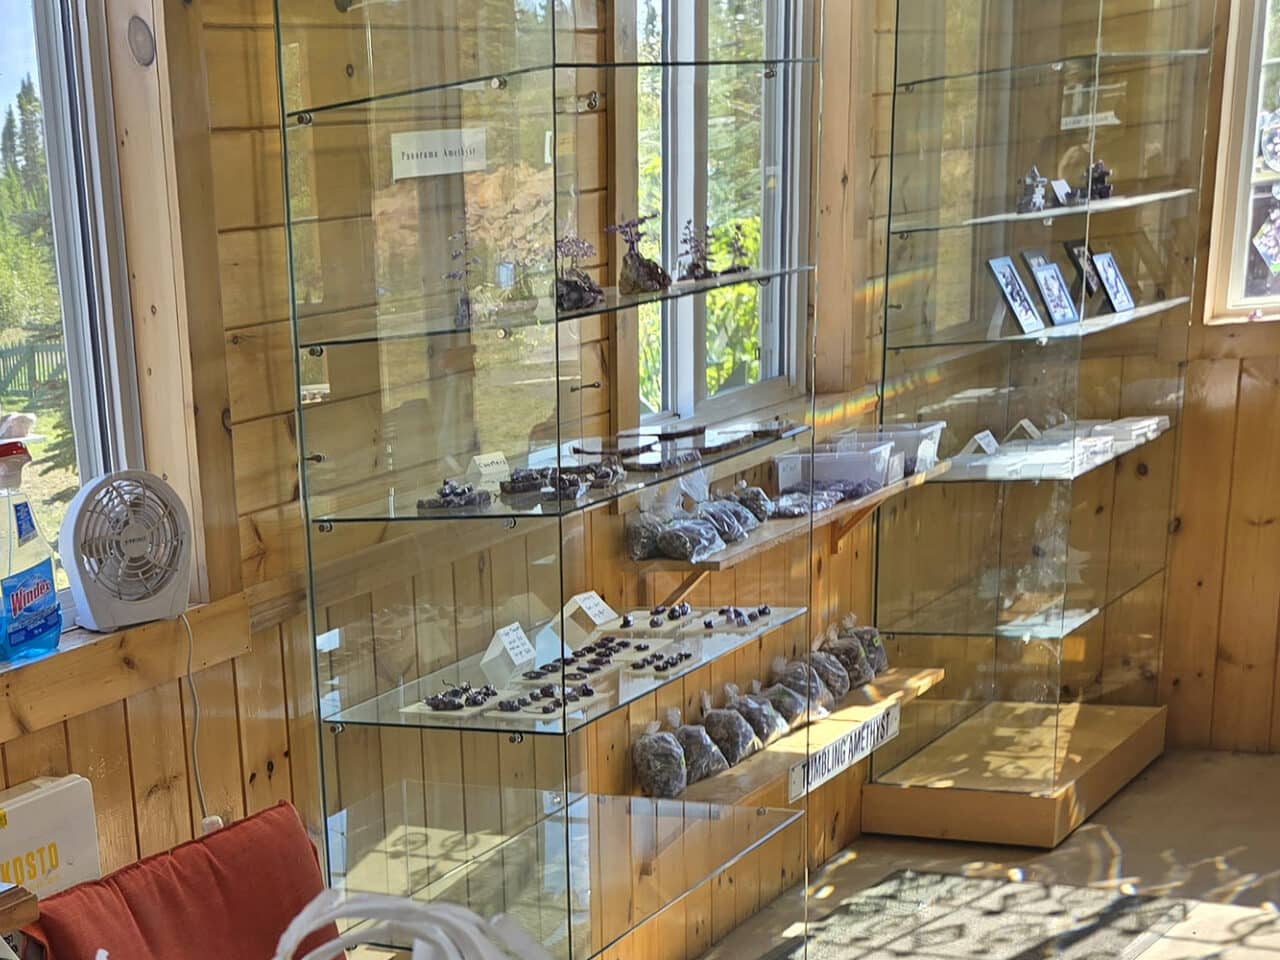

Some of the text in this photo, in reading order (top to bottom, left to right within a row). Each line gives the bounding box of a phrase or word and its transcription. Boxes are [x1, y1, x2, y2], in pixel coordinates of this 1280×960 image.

[10, 580, 51, 619] Windex
[801, 711, 891, 790] TUMBLING AMETHYST
[0, 842, 59, 886] KOSTO
